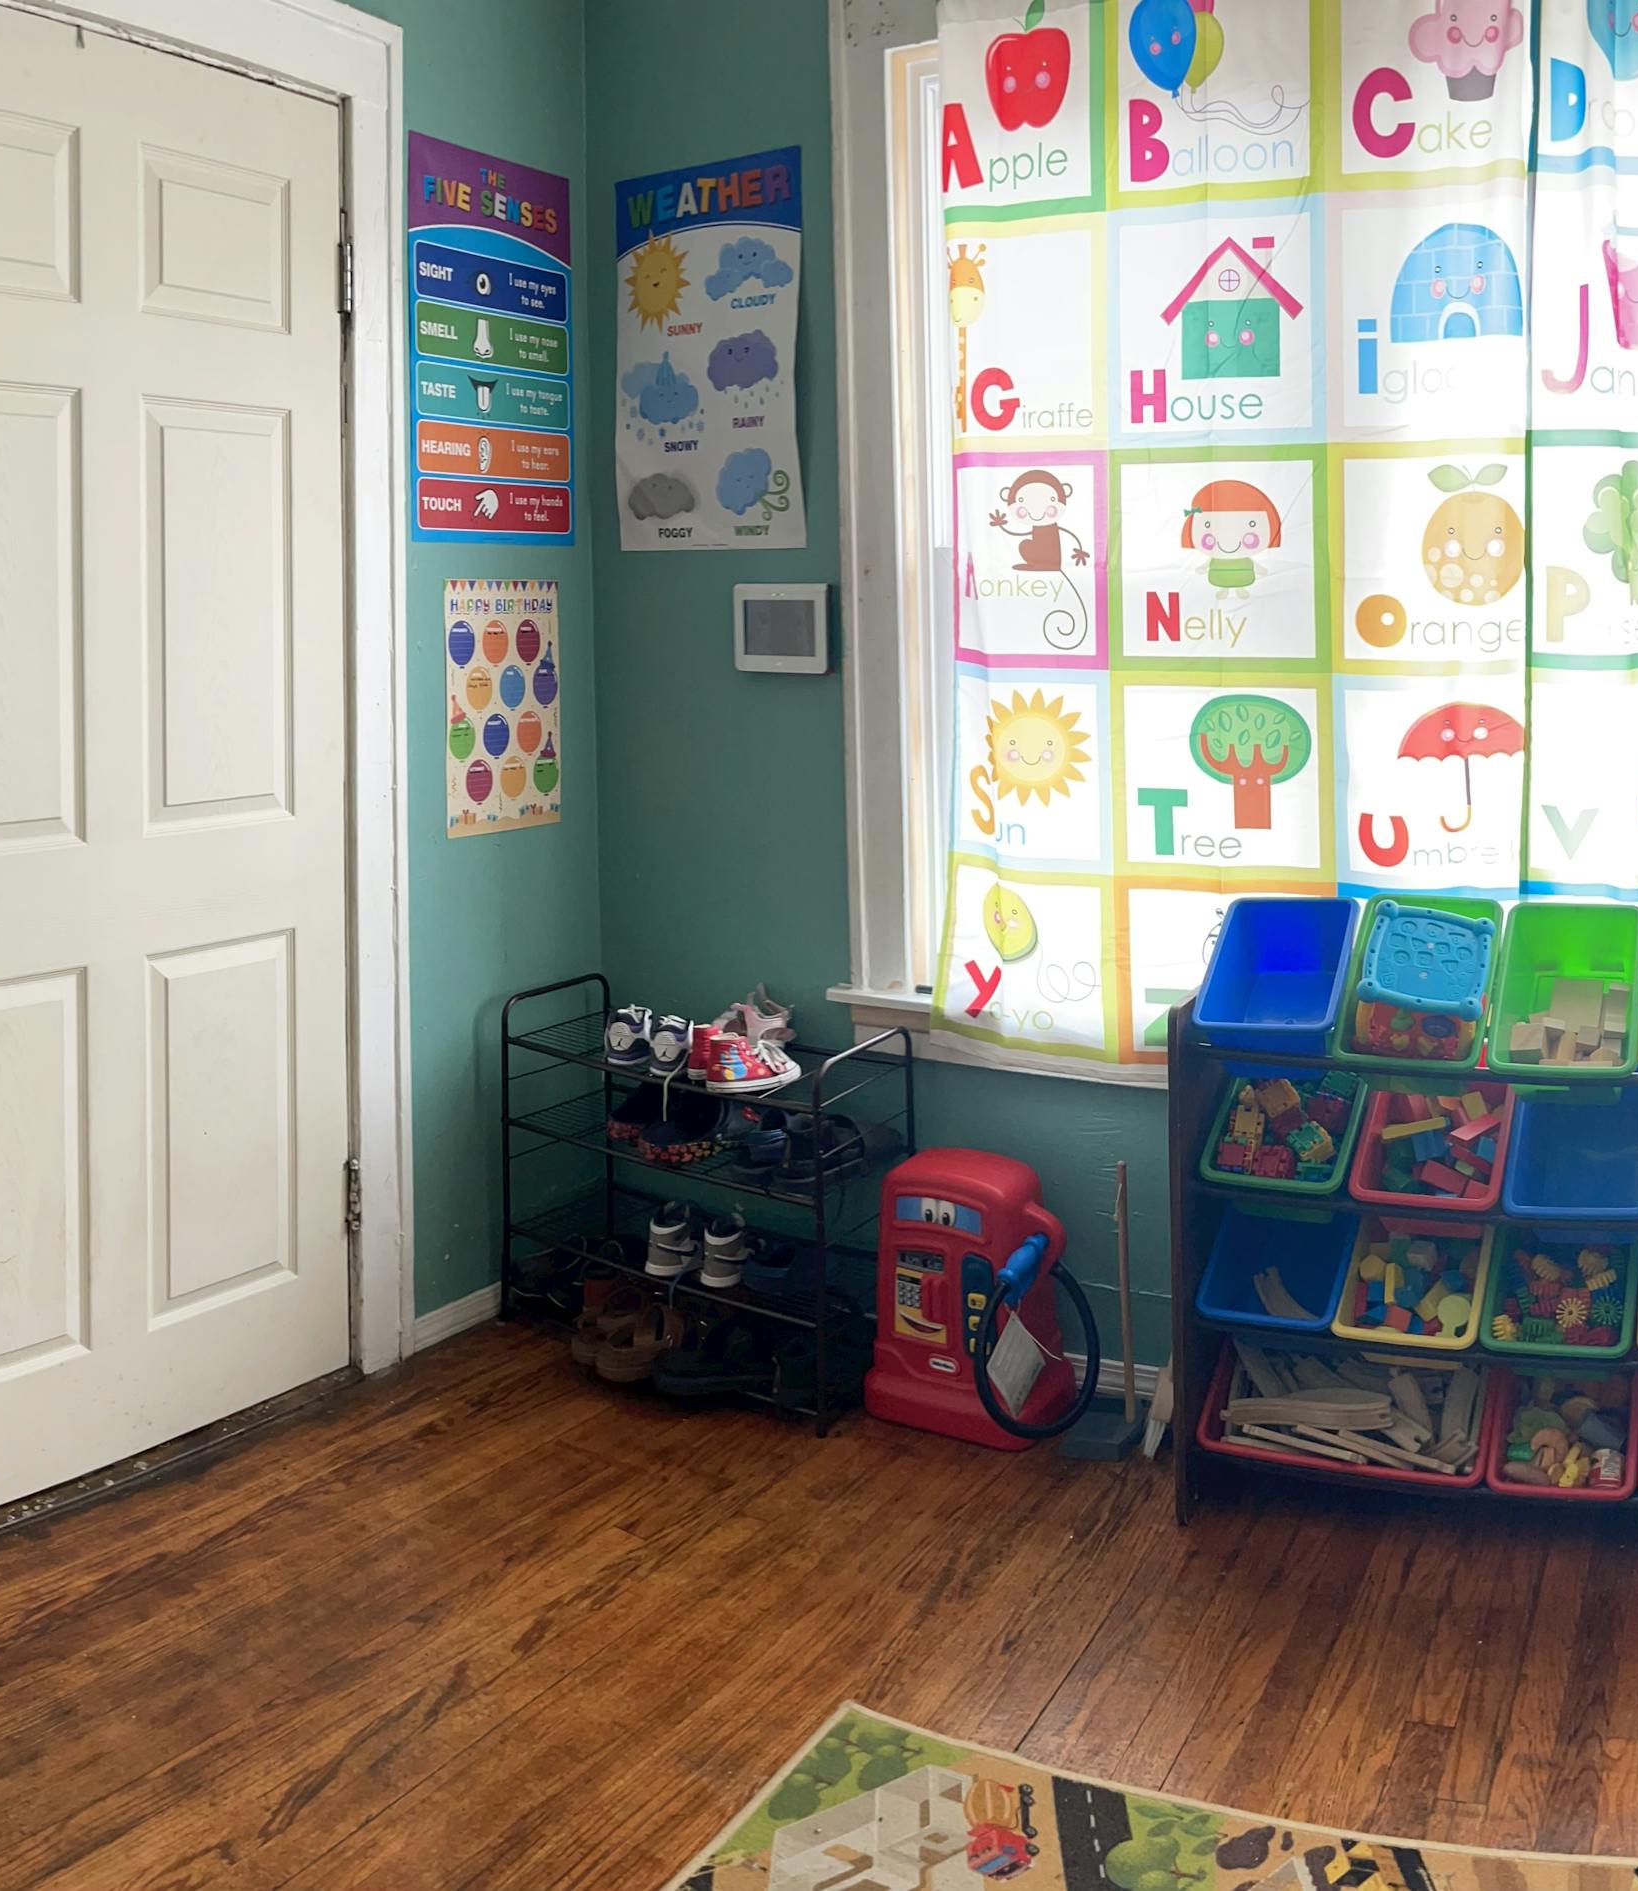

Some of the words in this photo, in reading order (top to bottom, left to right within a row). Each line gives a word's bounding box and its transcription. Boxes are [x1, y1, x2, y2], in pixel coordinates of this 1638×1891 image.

[1352, 66, 1492, 158] Cake
[943, 103, 1069, 193] Apple
[1129, 98, 1295, 183] Balloon
[479, 168, 505, 189] THE
[424, 174, 471, 212] FIVE
[481, 190, 558, 234] SENSES
[628, 163, 790, 229] WEATHER
[419, 262, 453, 281] SIGHT
[730, 293, 776, 310] CLOUDY
[420, 321, 457, 340] SMELL
[667, 322, 703, 337] SUNNY
[421, 381, 455, 399] TASTE
[970, 367, 1094, 431] Giraffe
[1130, 368, 1264, 425] House
[732, 415, 765, 429] RAINY
[422, 439, 471, 457] HEARING
[664, 440, 699, 453] SNOWY
[422, 497, 462, 512] TOUCH
[658, 527, 692, 539] FOGGY
[734, 525, 770, 537] WINDY
[450, 598, 490, 614] HAPPY
[495, 598, 553, 614] BIRTHDAY
[1146, 591, 1248, 650] Nelly
[1138, 788, 1243, 860] Tree
